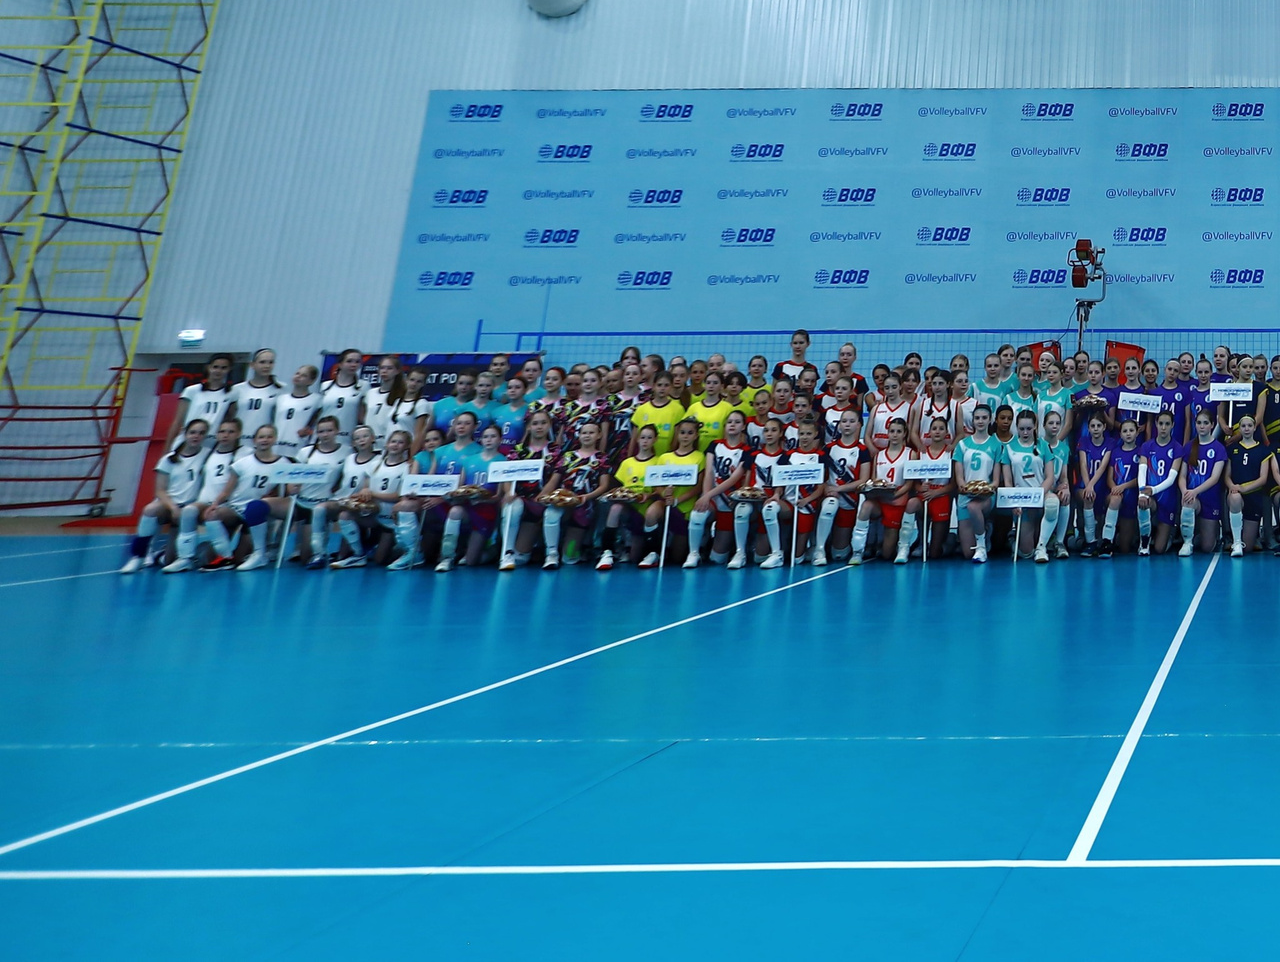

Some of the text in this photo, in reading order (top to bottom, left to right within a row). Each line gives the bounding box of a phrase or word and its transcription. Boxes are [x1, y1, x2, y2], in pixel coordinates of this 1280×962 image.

[465, 104, 504, 118] ВФВ
[655, 104, 694, 118] ВФВ
[726, 108, 796, 118] @VolleyballVFV
[845, 103, 883, 117] ВФВ
[918, 107, 987, 117] @VolleyballVFV
[1037, 103, 1074, 117] ВФВ
[1109, 107, 1177, 117] @VolleyballVFV
[1227, 103, 1264, 117] ВФВ
[554, 144, 593, 159] ВФВ
[746, 144, 784, 158] ВФВ
[818, 147, 888, 157] @VolleyballVFV
[938, 143, 976, 157] ВФВ
[1011, 147, 1081, 157] @VolleyballVFV
[1131, 143, 1168, 157] ВФВ
[1203, 147, 1272, 157] @VolleyballVFV
[449, 189, 489, 204] ВФВ
[644, 189, 683, 204] ВФВ
[717, 189, 788, 199] @VolleyballVFV
[837, 188, 876, 202] ВФВ
[912, 188, 982, 198] @VolleyballVFV
[1032, 188, 1070, 202] ВФВ
[1106, 188, 1176, 199] @VolleyballVFV
[1226, 188, 1264, 202] ВФВ
[540, 229, 580, 244] ВФВ
[737, 228, 776, 243] ВФВ
[810, 232, 881, 242] @VolleyballVFV
[932, 227, 971, 241] ВФВ
[1006, 231, 1077, 242] @VolleyballVFV
[1128, 227, 1167, 242] ВФВ
[1202, 231, 1272, 242] @VolleyballVFV
[434, 271, 475, 286] ВФВ
[633, 271, 673, 286] ВФВ
[707, 275, 780, 285] @VolleyballVFV
[830, 269, 870, 284] ВФВ
[905, 273, 976, 284] @VolleyballVFV
[1028, 268, 1067, 284] ВФВ
[1104, 273, 1175, 284] @VolleyballVFV
[1225, 269, 1264, 284] ВФВ
[248, 398, 262, 410] 10
[336, 397, 345, 408] 9
[1274, 393, 1280, 404] 9
[206, 401, 218, 414] 11
[286, 408, 295, 420] 8
[375, 403, 383, 415] 7
[502, 422, 511, 435] 6
[970, 452, 982, 471] 5
[1021, 454, 1033, 472] 2
[1242, 453, 1248, 466] 5
[216, 464, 224, 476] 2
[715, 456, 732, 478] 18
[837, 457, 847, 477] 3
[1124, 464, 1131, 481] 7
[1157, 459, 1165, 476] 8
[252, 474, 268, 488] 12
[886, 467, 895, 482] 4
[350, 476, 358, 488] 6
[381, 478, 389, 491] 3
